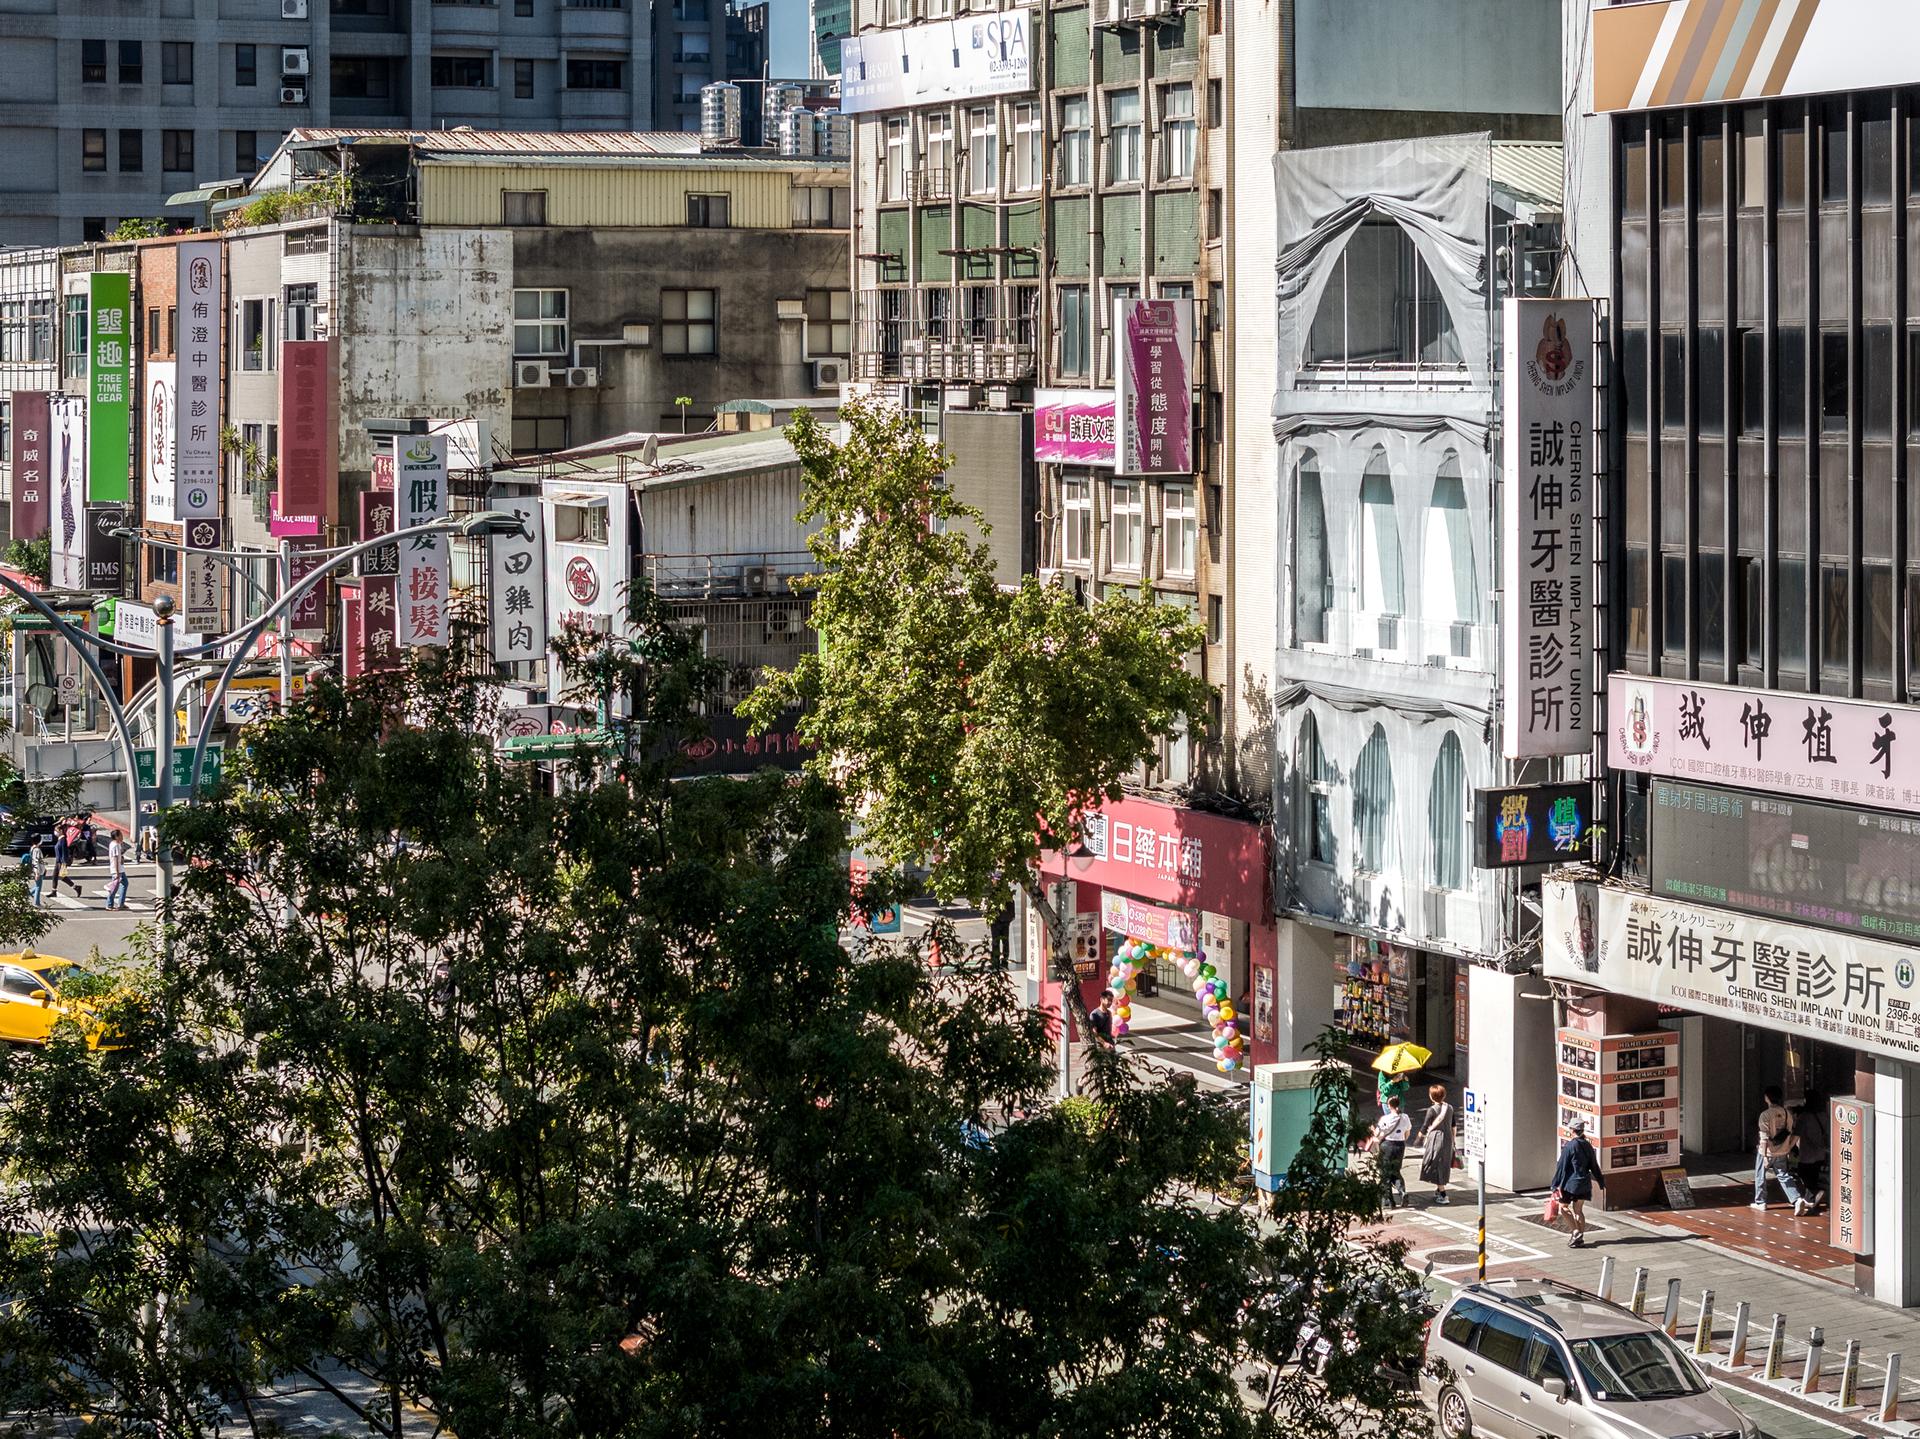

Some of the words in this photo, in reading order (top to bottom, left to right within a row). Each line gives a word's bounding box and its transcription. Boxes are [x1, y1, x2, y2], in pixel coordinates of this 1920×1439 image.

[987, 17, 1027, 59] SPA
[97, 393, 123, 402] GEAR
[98, 374, 122, 382] FREE
[98, 384, 122, 392] TIME
[191, 301, 209, 442] 侑澄中醫診所
[1150, 345, 1168, 468] 學習從態度開始
[22, 429, 39, 503] 奇威名品
[1570, 420, 1582, 503] CHERNG
[362, 546, 397, 573] 假髮
[1570, 514, 1582, 567] SHEN
[91, 562, 119, 575] HMS
[1528, 420, 1564, 733] 誠伸牙醫診所
[1570, 575, 1582, 659] IMPLANT
[294, 681, 300, 689] 6
[1570, 670, 1582, 731] UNION
[1679, 690, 1896, 779] 誠伸植牙
[1830, 778, 1860, 796] 理事長
[1113, 821, 1203, 879] 日藥本舖
[1626, 917, 1886, 1015] 誠伸牙醫診所
[1728, 985, 1767, 1003] CHERNG
[1771, 995, 1797, 1010] SHEN
[1801, 1002, 1843, 1021] IMPLANT
[1848, 1014, 1880, 1029] UNION
[1467, 1094, 1474, 1109] P
[1840, 1127, 1853, 1244] 誠伸牙醫診所
